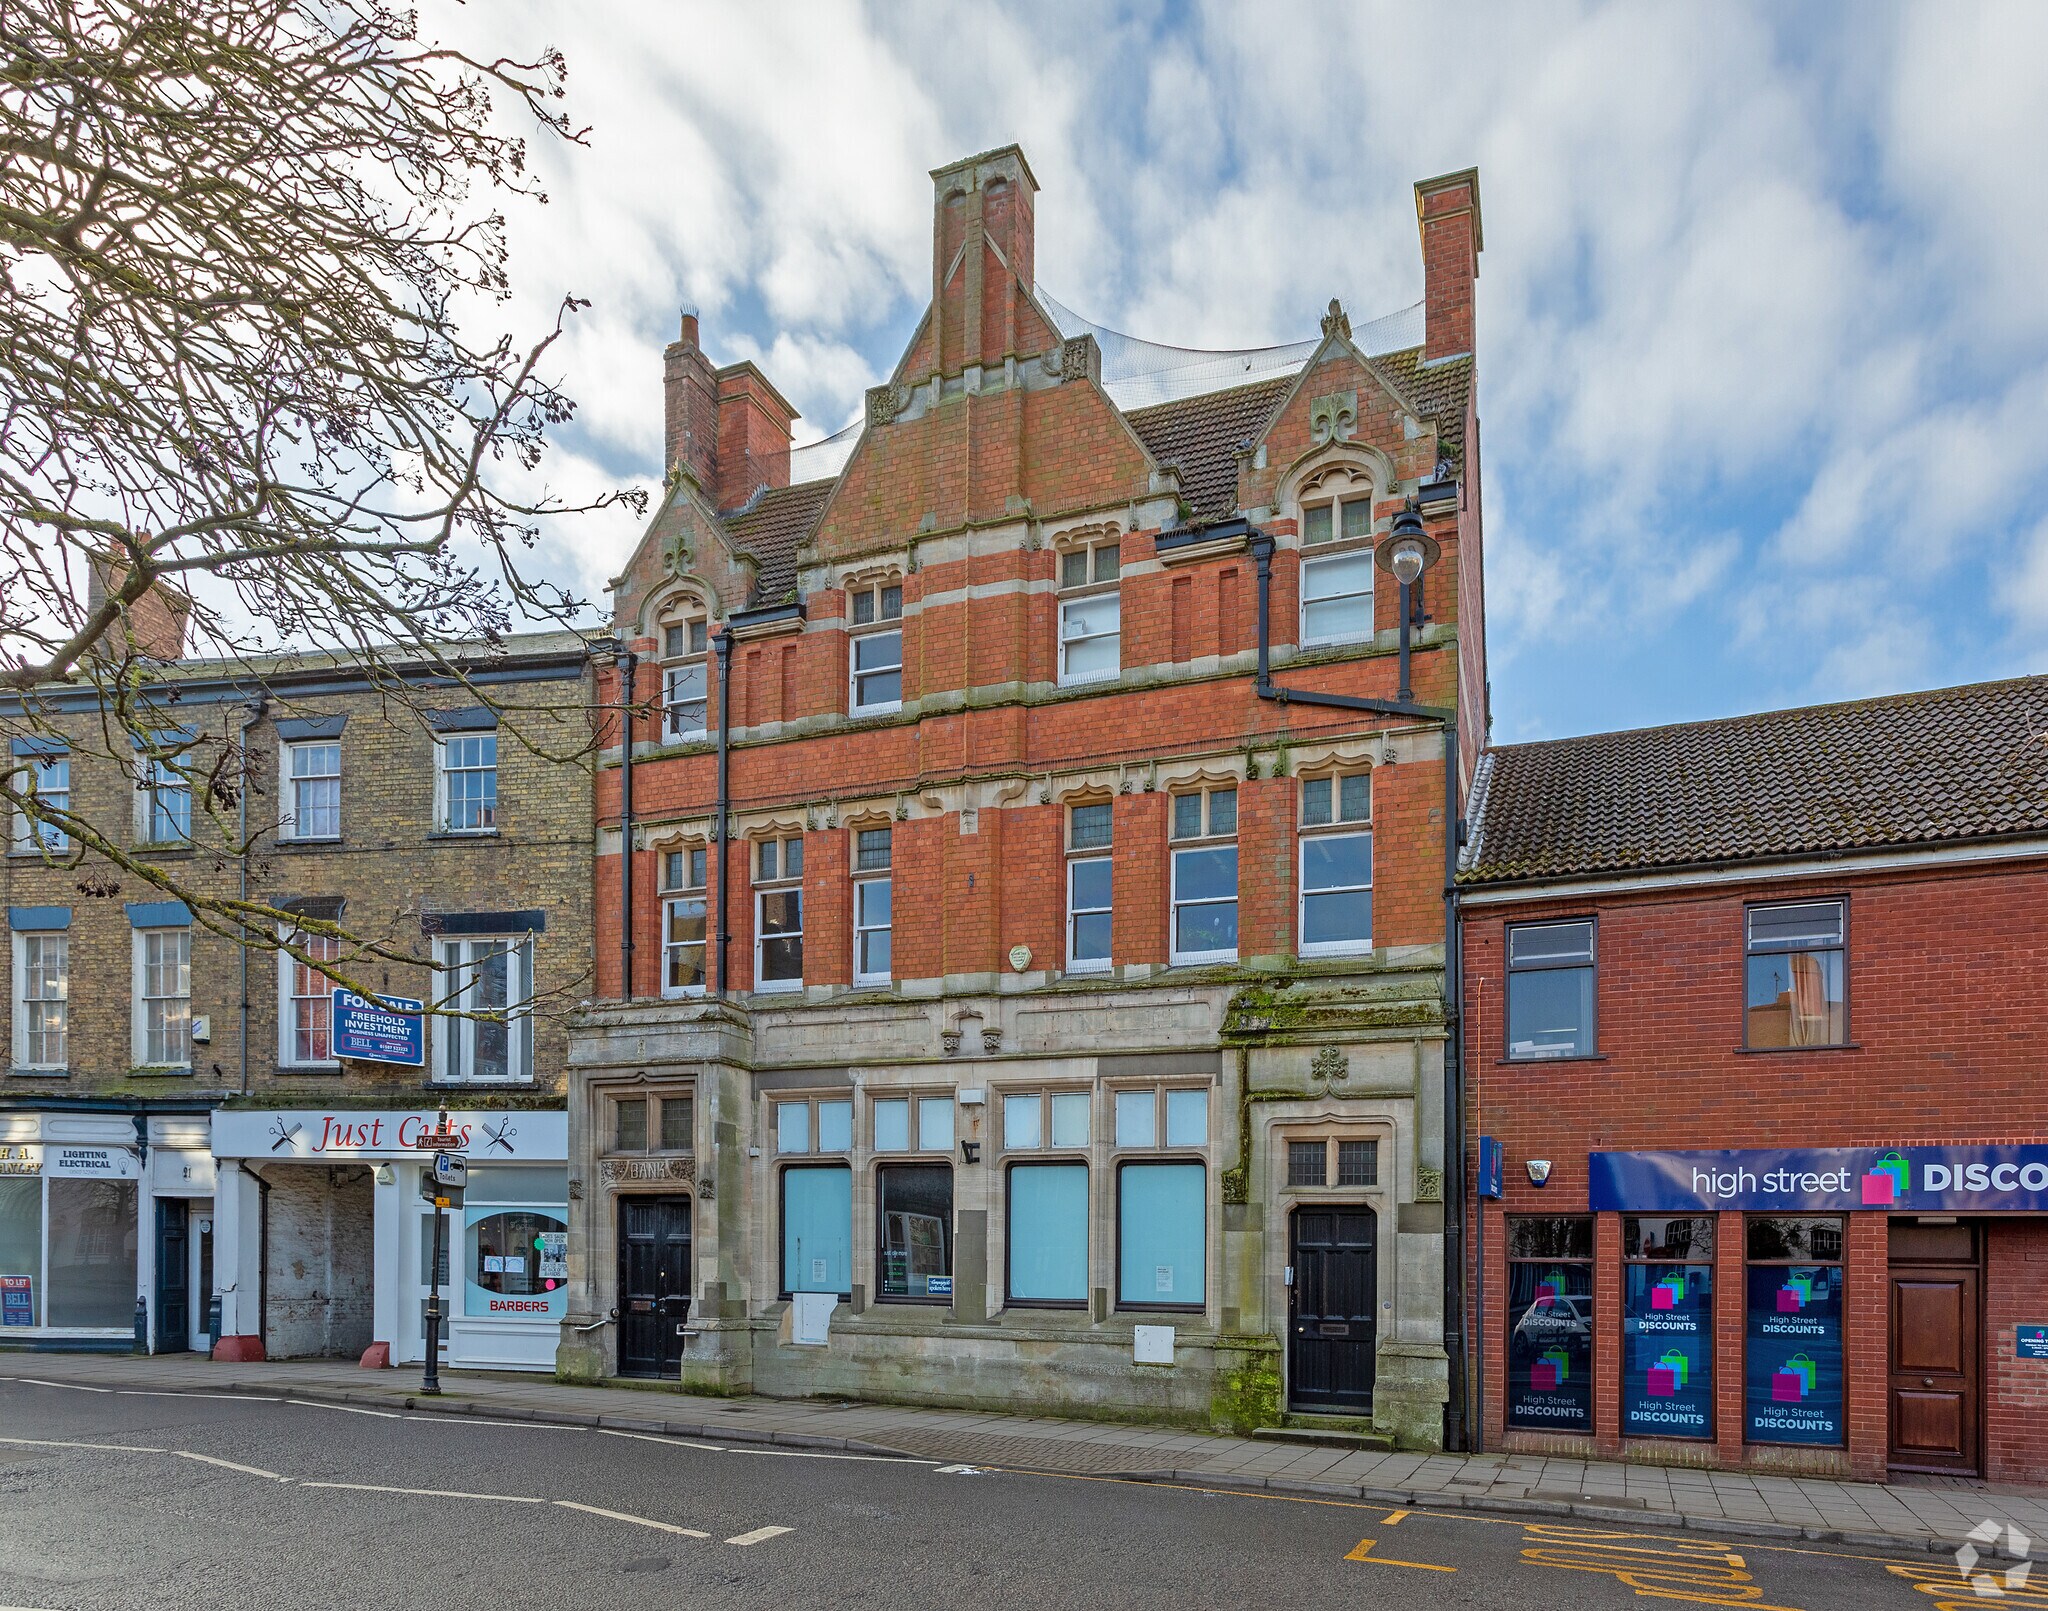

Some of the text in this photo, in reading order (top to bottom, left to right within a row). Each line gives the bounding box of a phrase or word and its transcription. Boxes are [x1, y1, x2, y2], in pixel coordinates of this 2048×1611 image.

[351, 1011, 406, 1026] FREEHOLD
[344, 1019, 412, 1036] INVESTMENT
[349, 1028, 409, 1041] BUSINESS UNAFFECTED
[350, 1036, 373, 1048] BELL
[311, 1116, 384, 1152] Just
[62, 1150, 108, 1160] LIGHTING
[59, 1159, 111, 1169] ELECTRICAL
[441, 1157, 448, 1171] P
[183, 1166, 192, 1179] 21
[630, 1161, 667, 1180] BANK
[439, 1172, 456, 1182] Toilets
[1691, 1166, 1851, 1199] high street
[1923, 1162, 2048, 1193] DISCO
[5, 1293, 29, 1306] BELL
[490, 1300, 549, 1312] BARBERS
[1523, 1318, 1577, 1327] DISCOUNTS
[1645, 1312, 1690, 1321] High Street
[1769, 1315, 1817, 1324] High Street
[1638, 1321, 1697, 1331] DISCOUNTS
[1762, 1324, 1825, 1334] DISCOUNTS
[1523, 1395, 1576, 1405] High Street
[1639, 1400, 1696, 1412] High Street
[1515, 1405, 1584, 1418] DISCOUNTS
[1630, 1411, 1705, 1424] DISCOUNTS
[1763, 1406, 1824, 1418] High Street
[1754, 1417, 1834, 1431] DISCOUNTS
